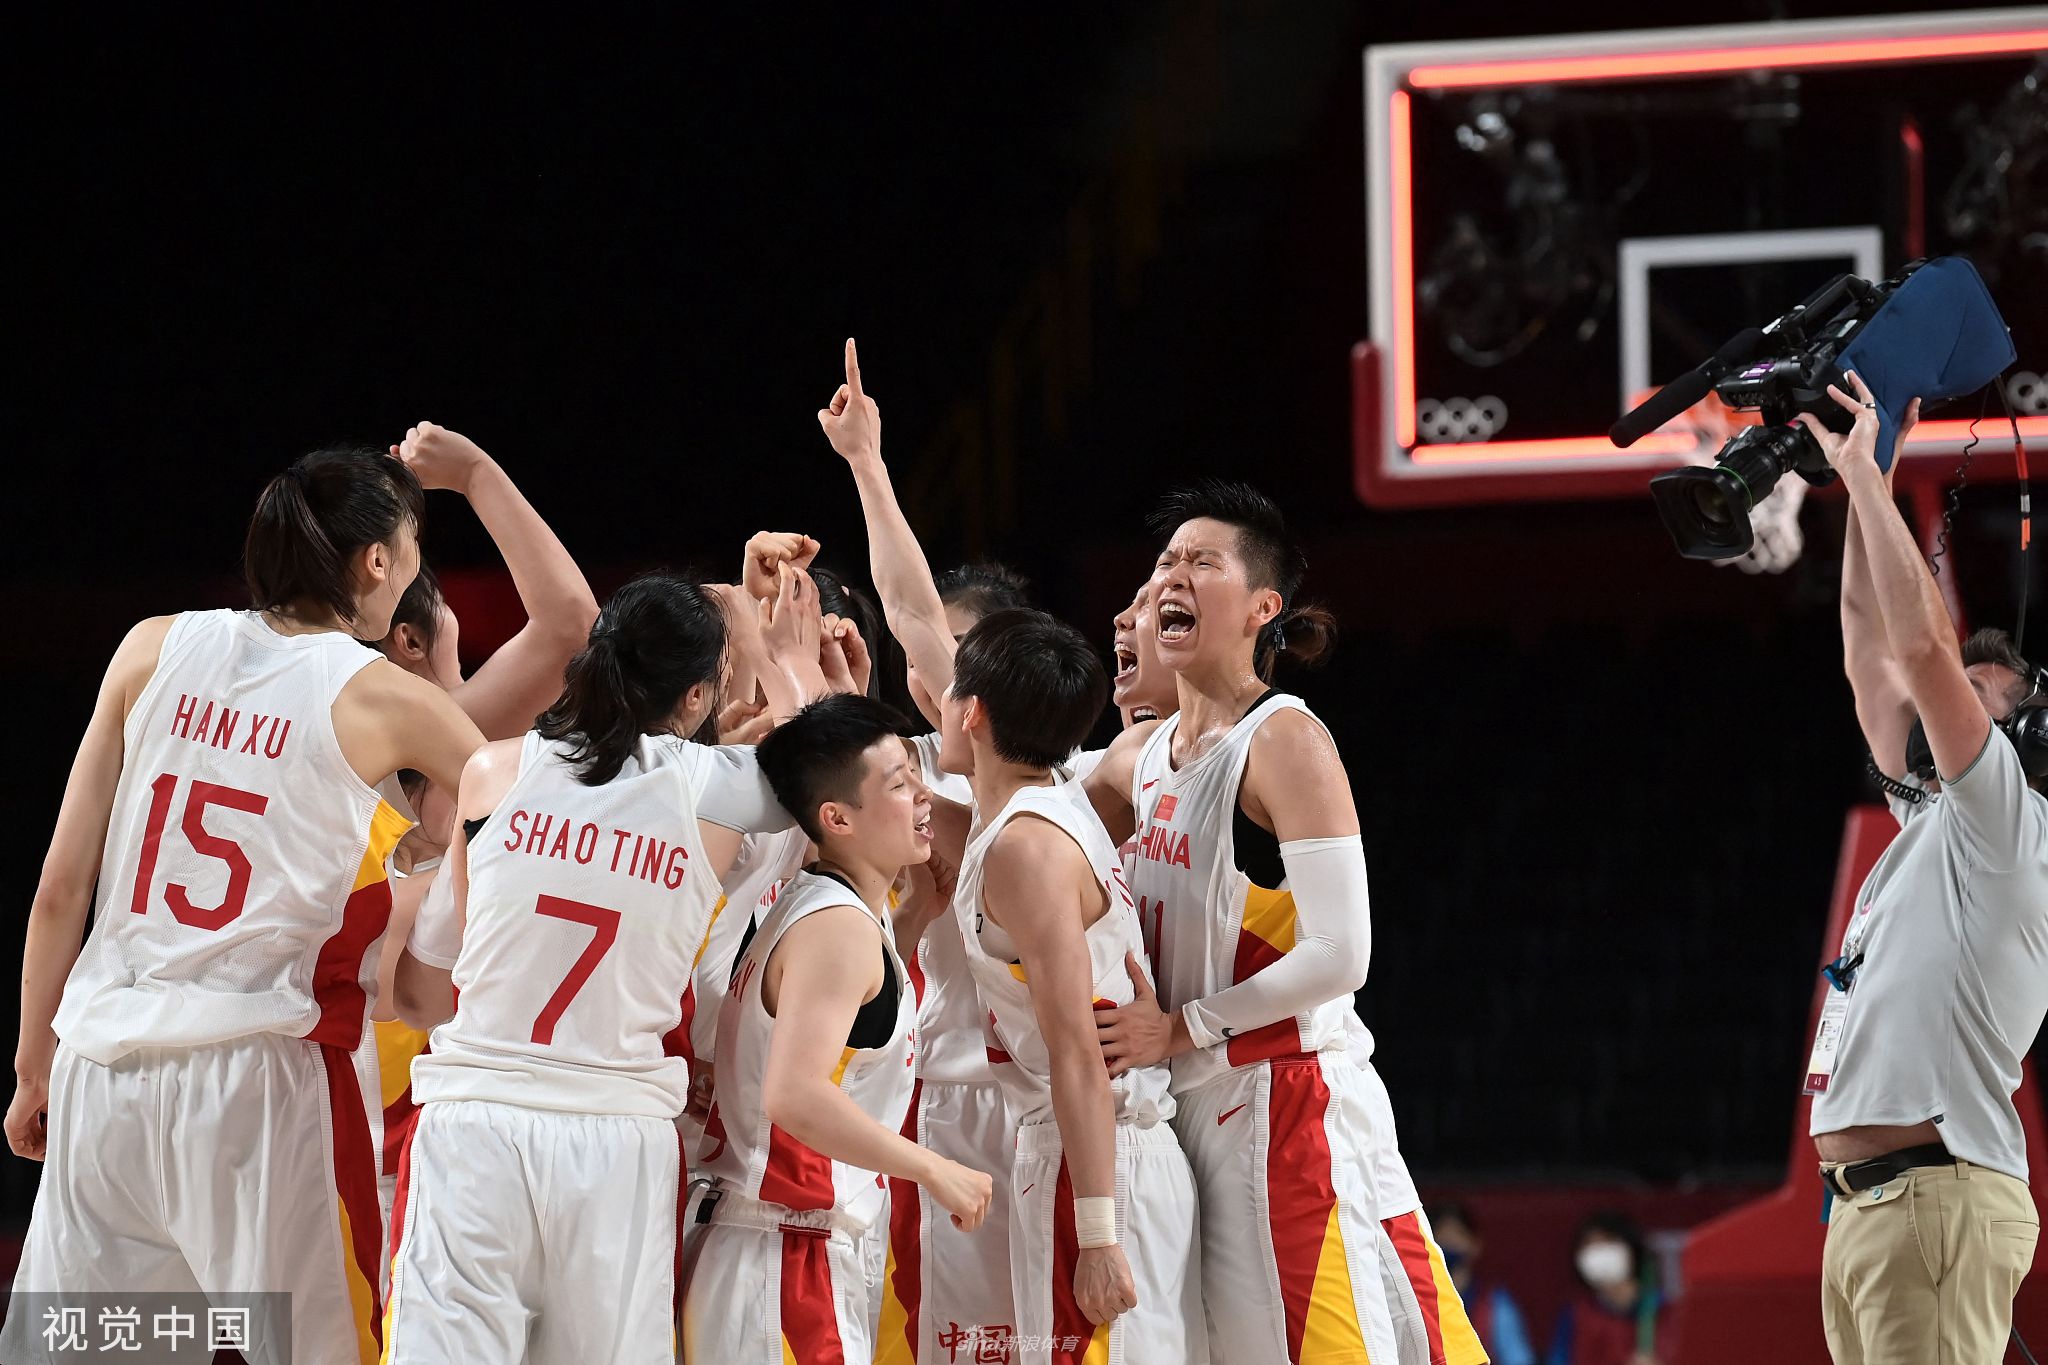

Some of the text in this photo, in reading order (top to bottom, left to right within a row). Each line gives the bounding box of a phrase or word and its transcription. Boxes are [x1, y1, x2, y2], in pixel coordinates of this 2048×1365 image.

[170, 694, 292, 759] HAN XU
[131, 773, 269, 931] 15
[504, 810, 689, 890] SHAO TING
[1138, 820, 1191, 870] HINA
[530, 894, 622, 1045] 7
[938, 1321, 1012, 1365] 中国
